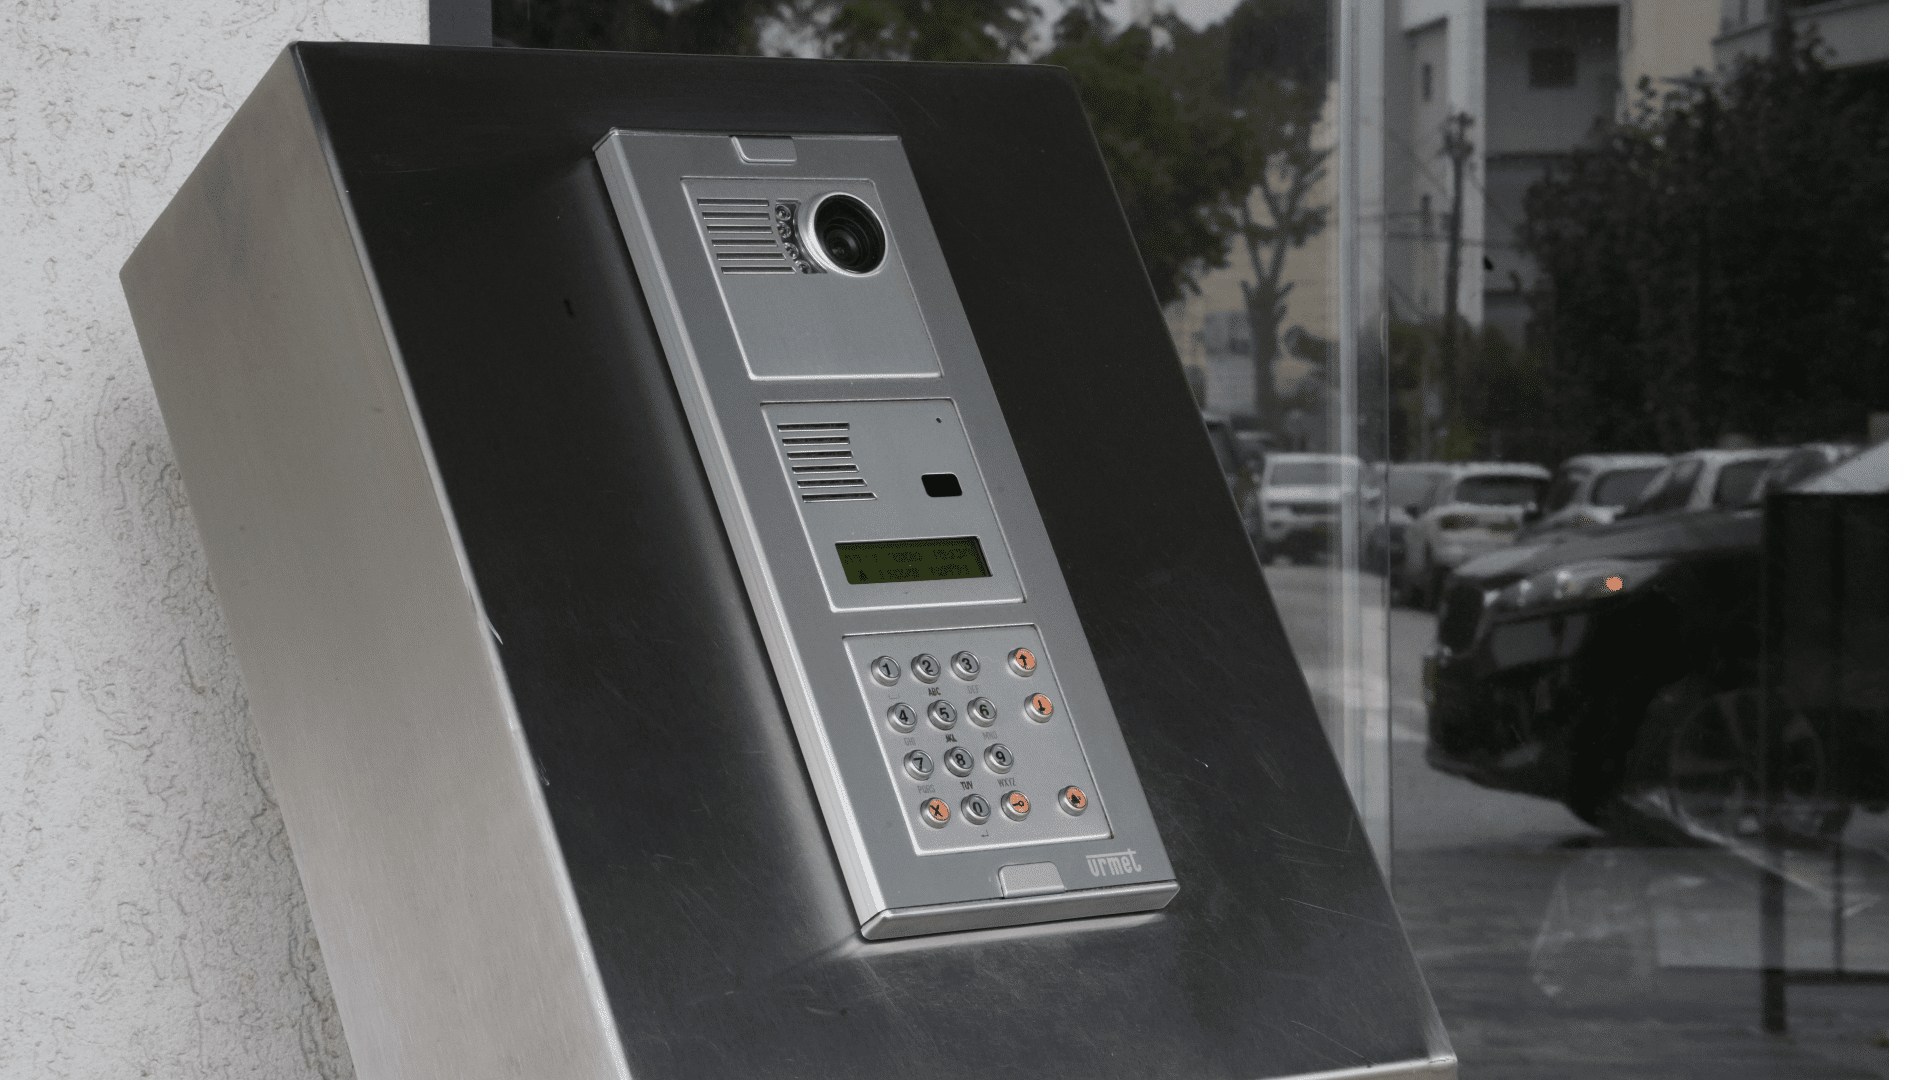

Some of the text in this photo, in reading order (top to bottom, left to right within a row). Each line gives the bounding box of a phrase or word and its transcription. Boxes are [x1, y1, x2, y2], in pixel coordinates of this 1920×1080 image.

[882, 657, 973, 677] 1 2 3
[928, 685, 979, 696] ABC DEF
[899, 704, 990, 722] 4 5 6
[913, 750, 1006, 771] 7 8 9
[960, 781, 973, 790] TUV
[997, 778, 1016, 788] WXYZ
[972, 801, 983, 814] 0
[1085, 848, 1142, 877] urmet
